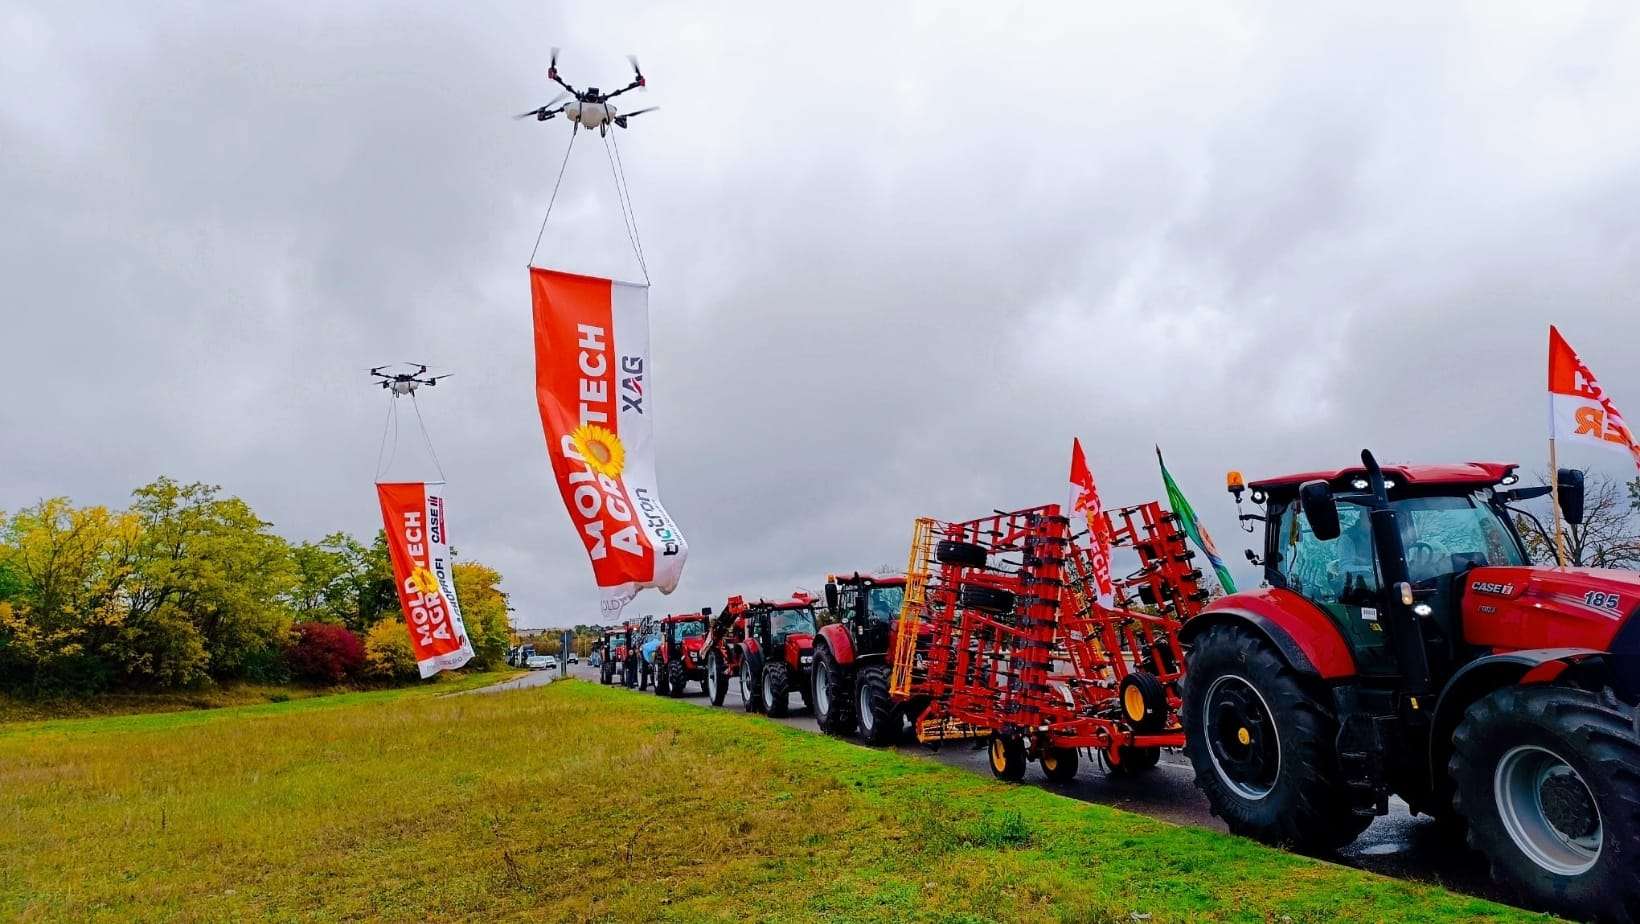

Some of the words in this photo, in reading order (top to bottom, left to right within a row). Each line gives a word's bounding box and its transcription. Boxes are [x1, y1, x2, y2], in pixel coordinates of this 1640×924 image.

[577, 323, 608, 426] TECH
[622, 355, 643, 414] XAG
[430, 508, 440, 543] CASE
[635, 488, 679, 556] biotron
[404, 577, 433, 646] MOLD
[1471, 581, 1502, 594] CASE
[1584, 590, 1620, 610] 185
